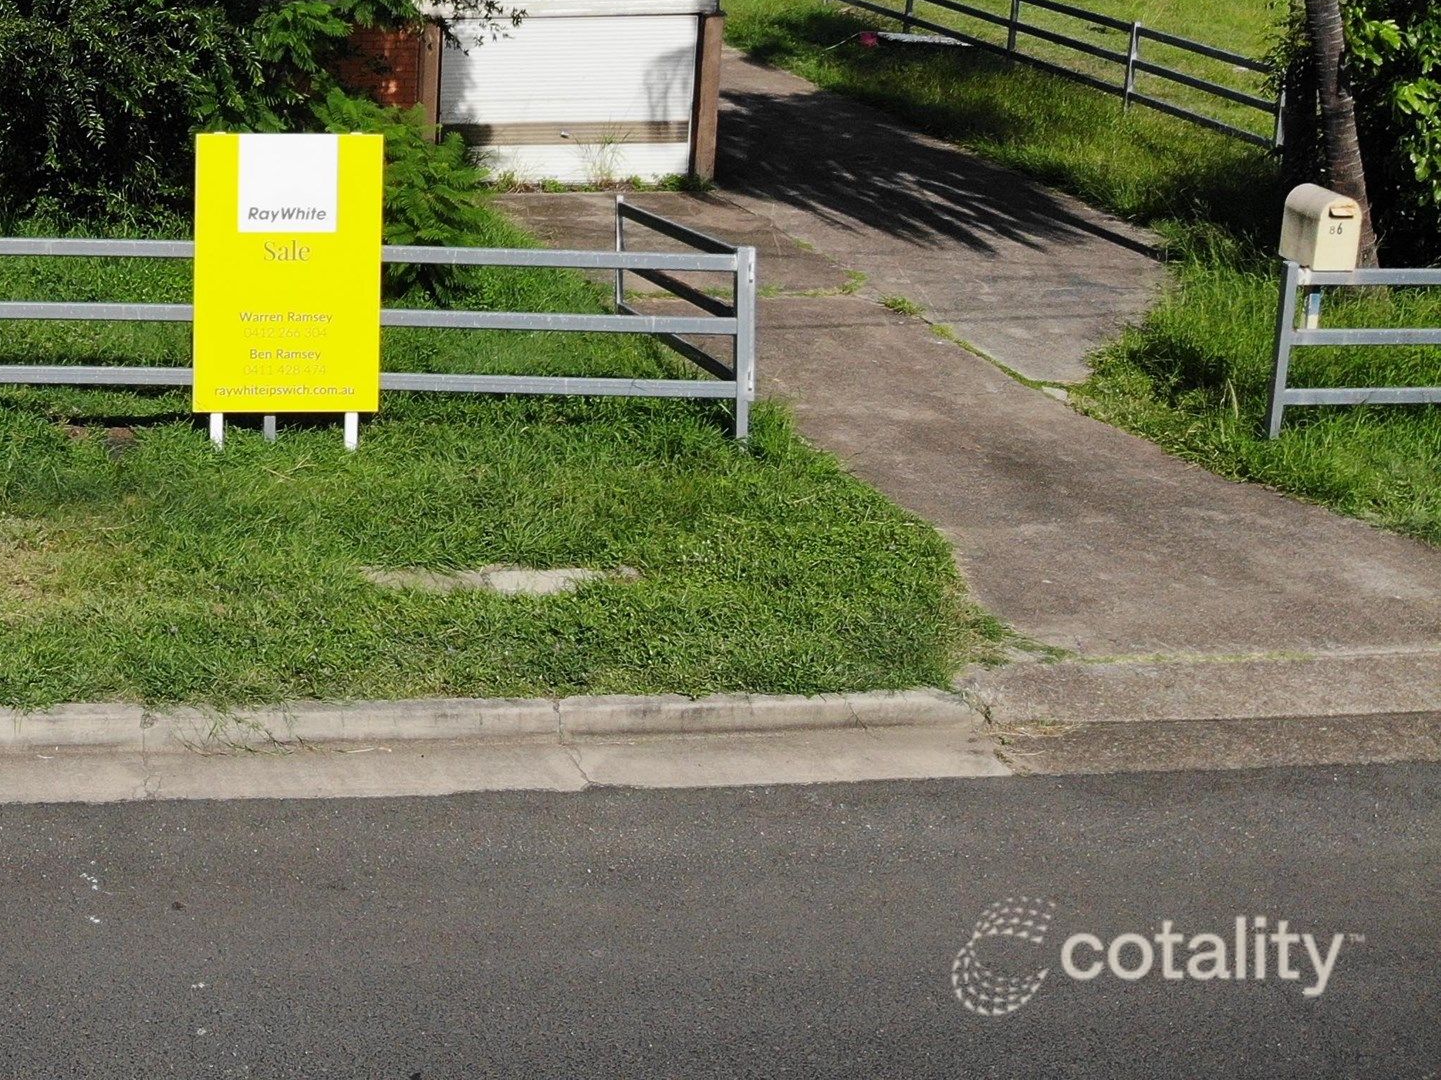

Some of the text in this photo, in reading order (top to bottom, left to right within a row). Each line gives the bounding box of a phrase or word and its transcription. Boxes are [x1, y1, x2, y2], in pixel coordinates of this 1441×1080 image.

[263, 239, 311, 262] Sale
[239, 311, 333, 324] Warren Ramsey
[249, 349, 321, 362] Ben Ramsey
[214, 384, 355, 397] raywhiteipswich.com.au
